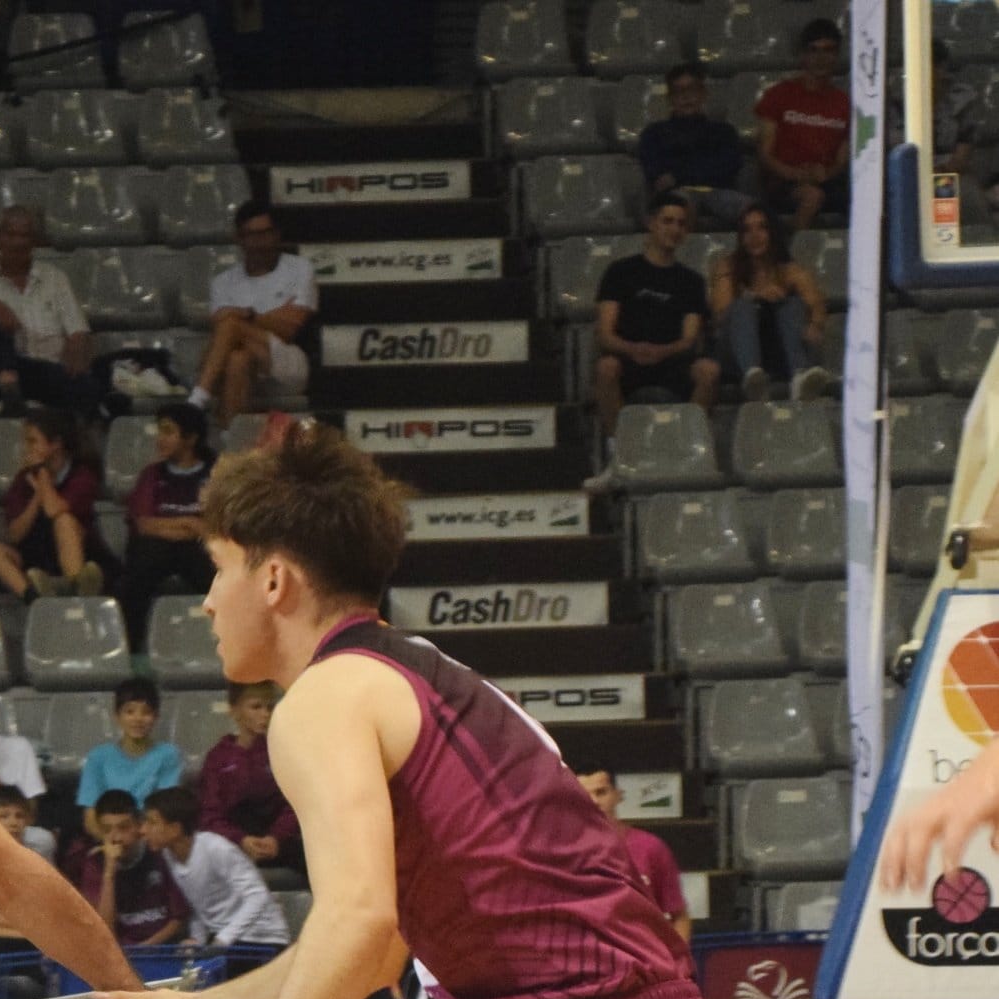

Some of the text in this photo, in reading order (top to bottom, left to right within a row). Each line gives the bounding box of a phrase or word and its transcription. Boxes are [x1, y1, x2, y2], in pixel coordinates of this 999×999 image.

[348, 250, 452, 271] www.icg.es
[358, 326, 493, 361] CashDro
[426, 507, 537, 528] www.icg.es
[428, 589, 570, 626] CashDro
